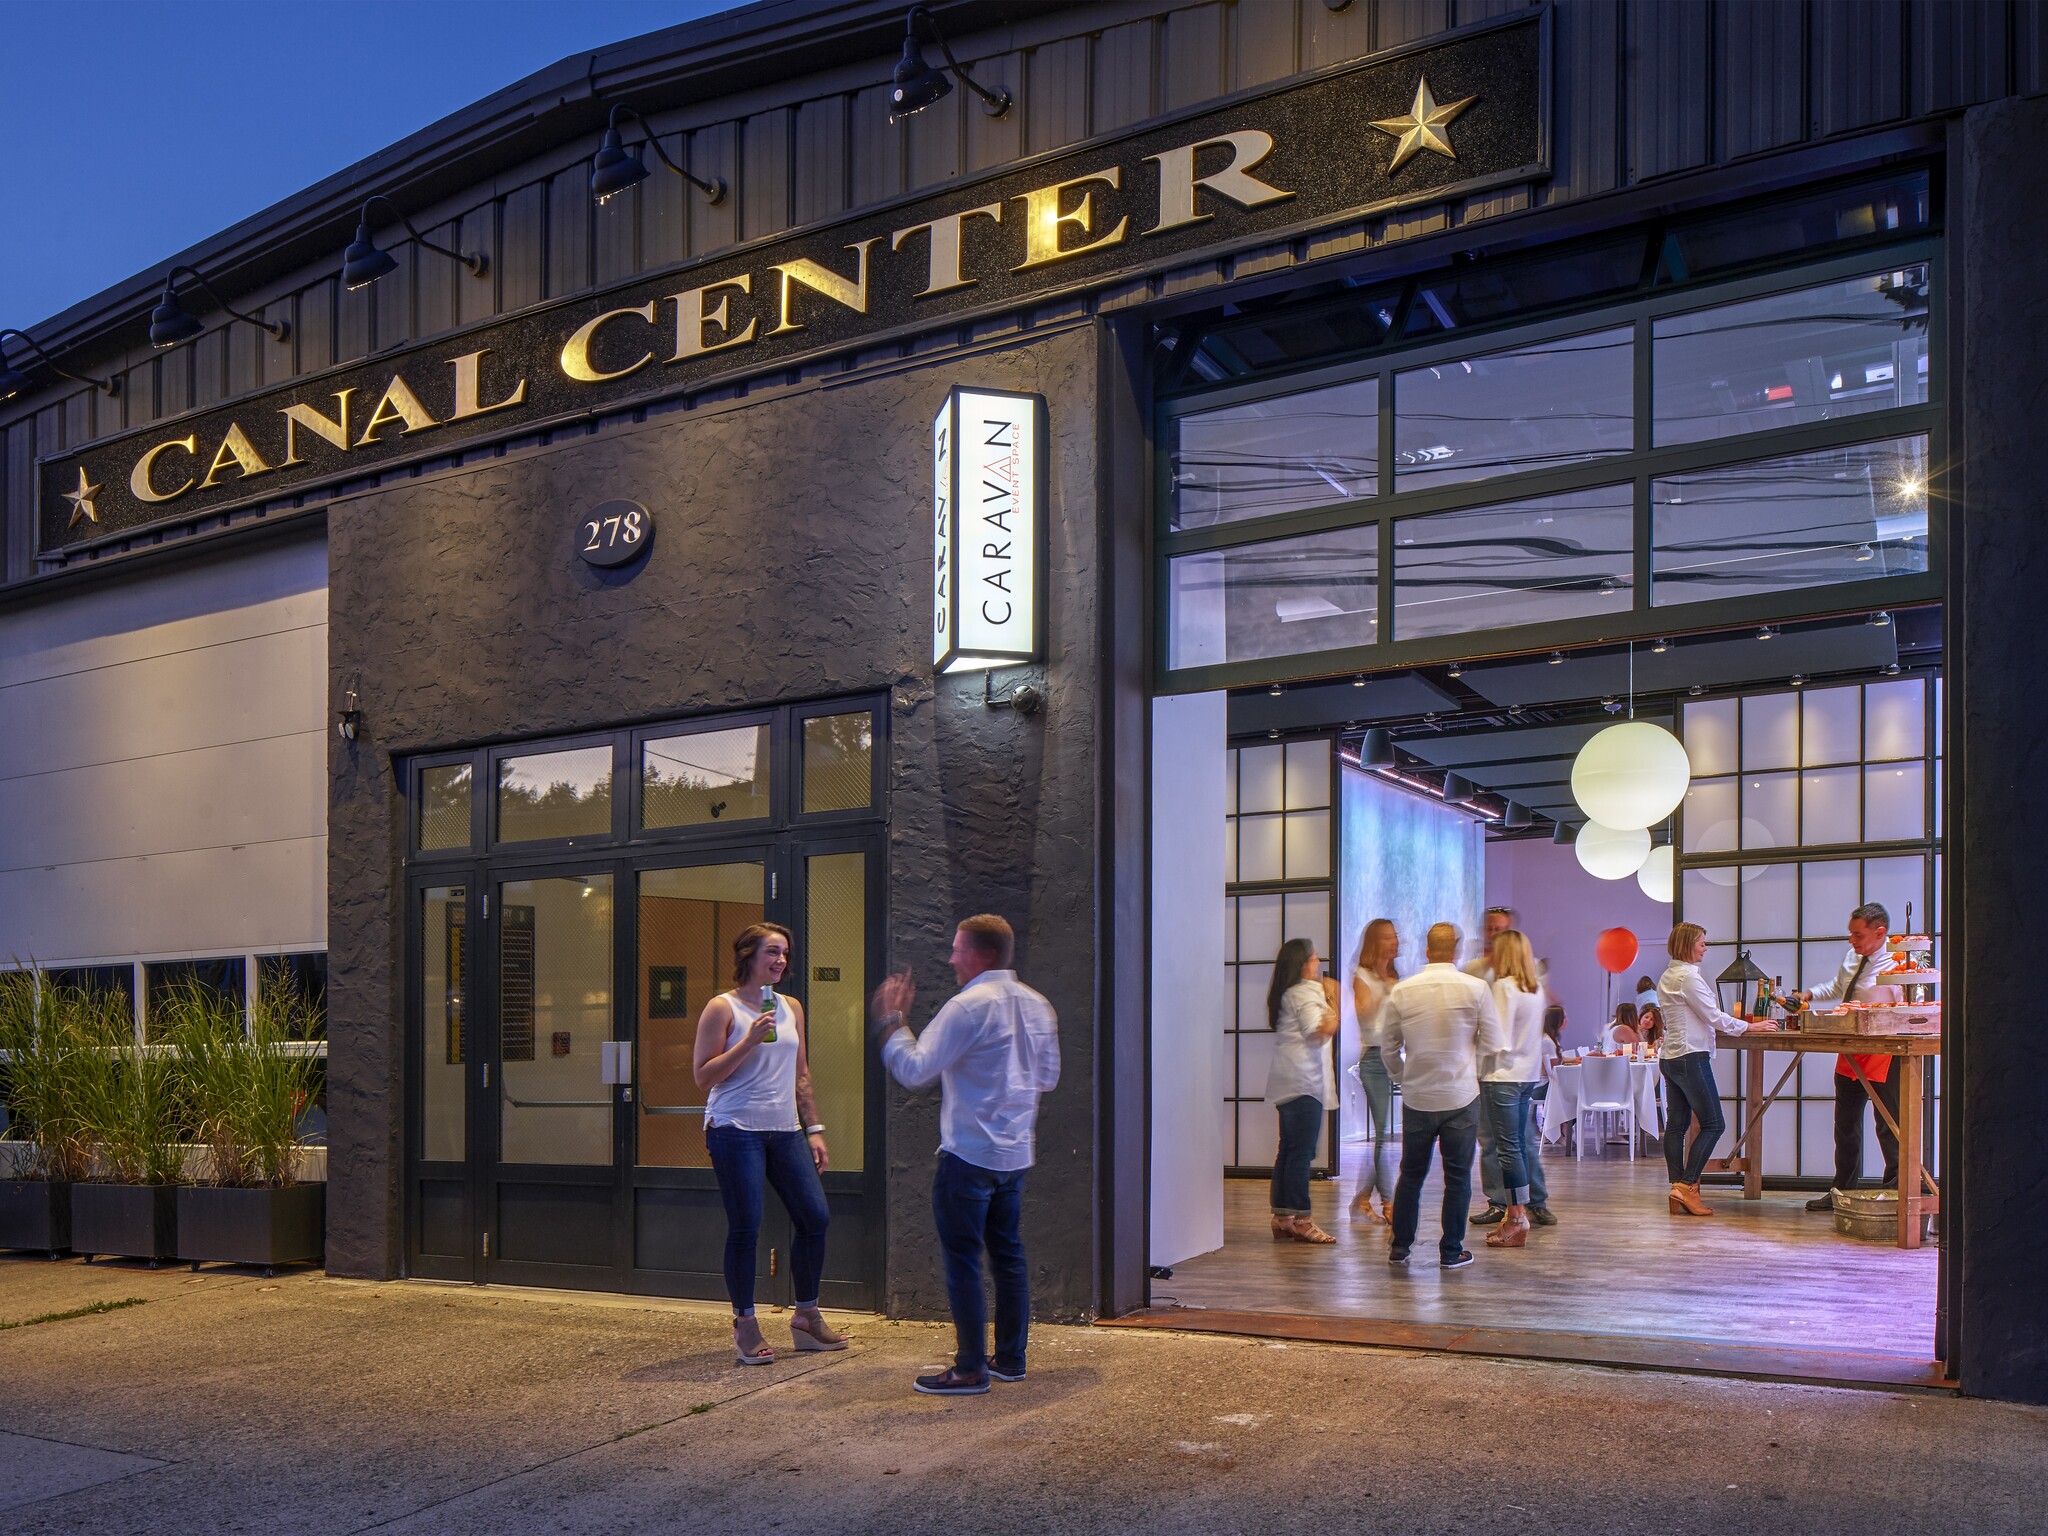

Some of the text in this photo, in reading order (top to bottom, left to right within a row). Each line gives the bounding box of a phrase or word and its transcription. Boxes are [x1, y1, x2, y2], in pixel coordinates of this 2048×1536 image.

[130, 129, 1297, 503] CANAL CENTER
[583, 511, 641, 551] 278
[982, 419, 1012, 625] CARAVAN
[1012, 423, 1020, 514] EVENT SPACE
